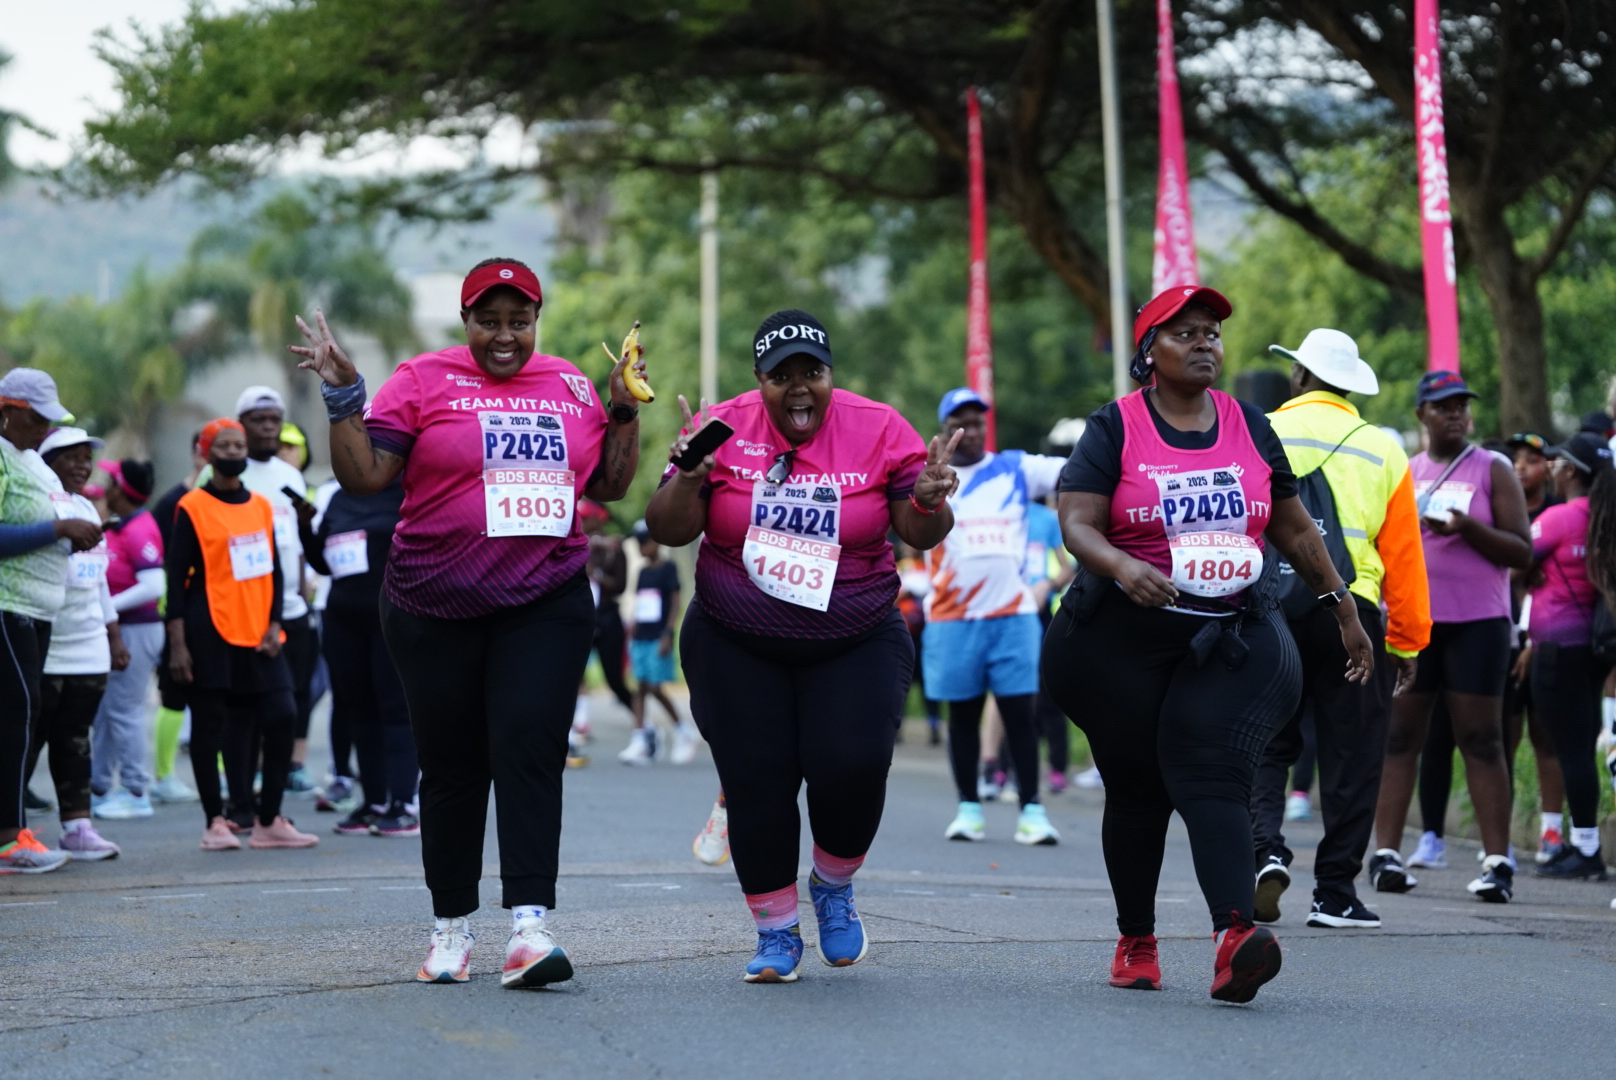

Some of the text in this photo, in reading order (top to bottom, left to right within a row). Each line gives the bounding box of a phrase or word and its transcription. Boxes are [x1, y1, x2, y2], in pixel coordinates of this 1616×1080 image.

[755, 324, 826, 358] SPORT
[448, 397, 583, 419] TEAM VITALITY
[509, 416, 532, 426] 2025
[485, 432, 565, 462] P2425
[729, 466, 868, 487] TEA VITALITY
[1147, 463, 1178, 471] Discovery
[495, 471, 565, 485] BDS RACE
[1186, 476, 1208, 487] 2025
[785, 488, 807, 498] 2025
[815, 488, 835, 497] ASA
[498, 496, 566, 519] 1803
[1126, 505, 1164, 523] TEA
[1163, 490, 1245, 527] P2426
[755, 503, 836, 538] P2424
[757, 531, 831, 558] BDS RACE
[1180, 533, 1250, 548] BDS RACE
[753, 555, 824, 590] 1403
[1184, 559, 1252, 580] 1804
